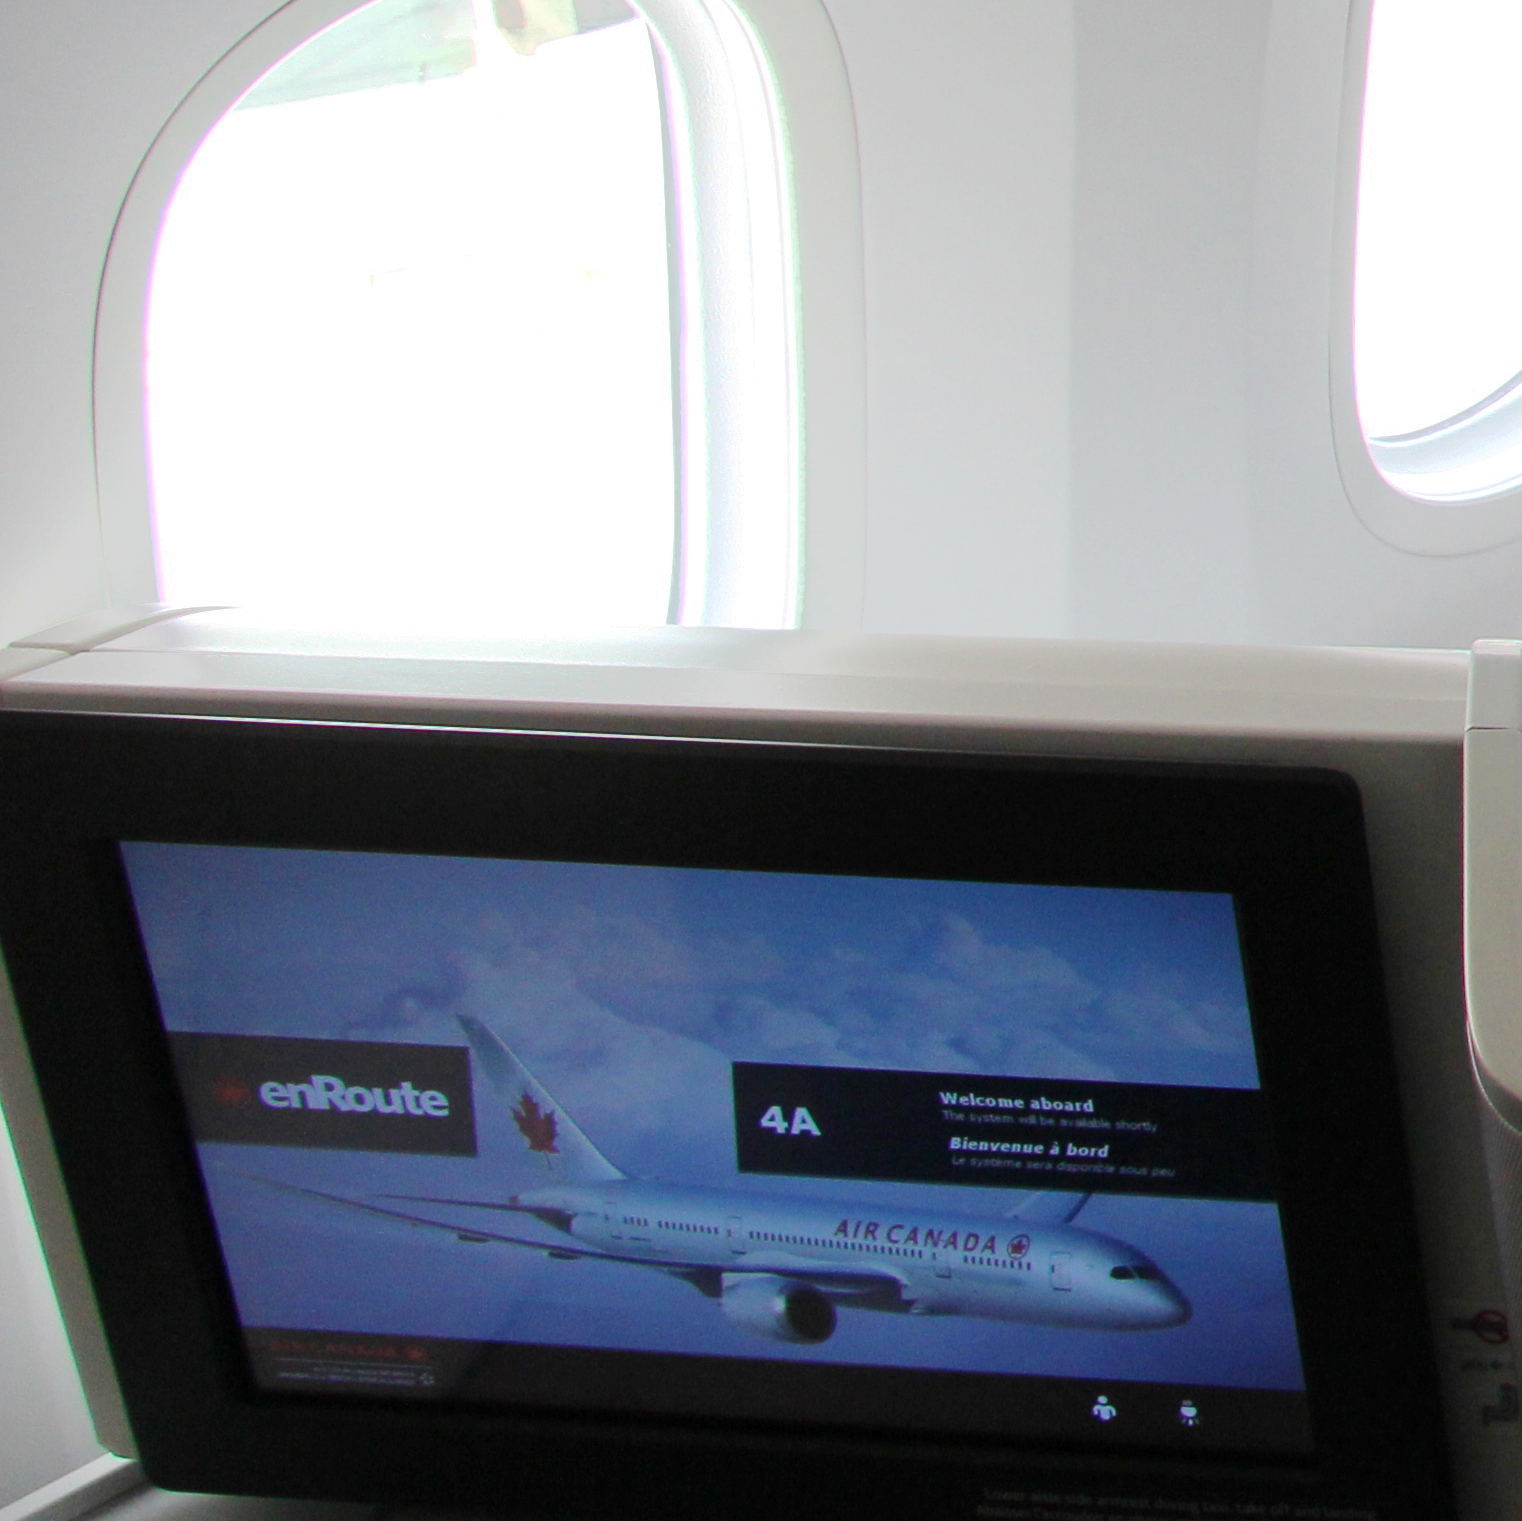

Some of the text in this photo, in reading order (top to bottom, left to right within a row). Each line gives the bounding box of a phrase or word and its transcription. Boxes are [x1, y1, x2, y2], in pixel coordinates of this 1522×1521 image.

[258, 1075, 449, 1117] enRoute
[939, 1091, 1095, 1113] Welcome aboard
[759, 1105, 821, 1136] 4A
[942, 1109, 965, 1122] The
[968, 1111, 1014, 1125] system
[1039, 1114, 1055, 1126] be
[949, 1136, 1109, 1158] Bienvenue à bord
[834, 1219, 997, 1255] AIR CANADA
